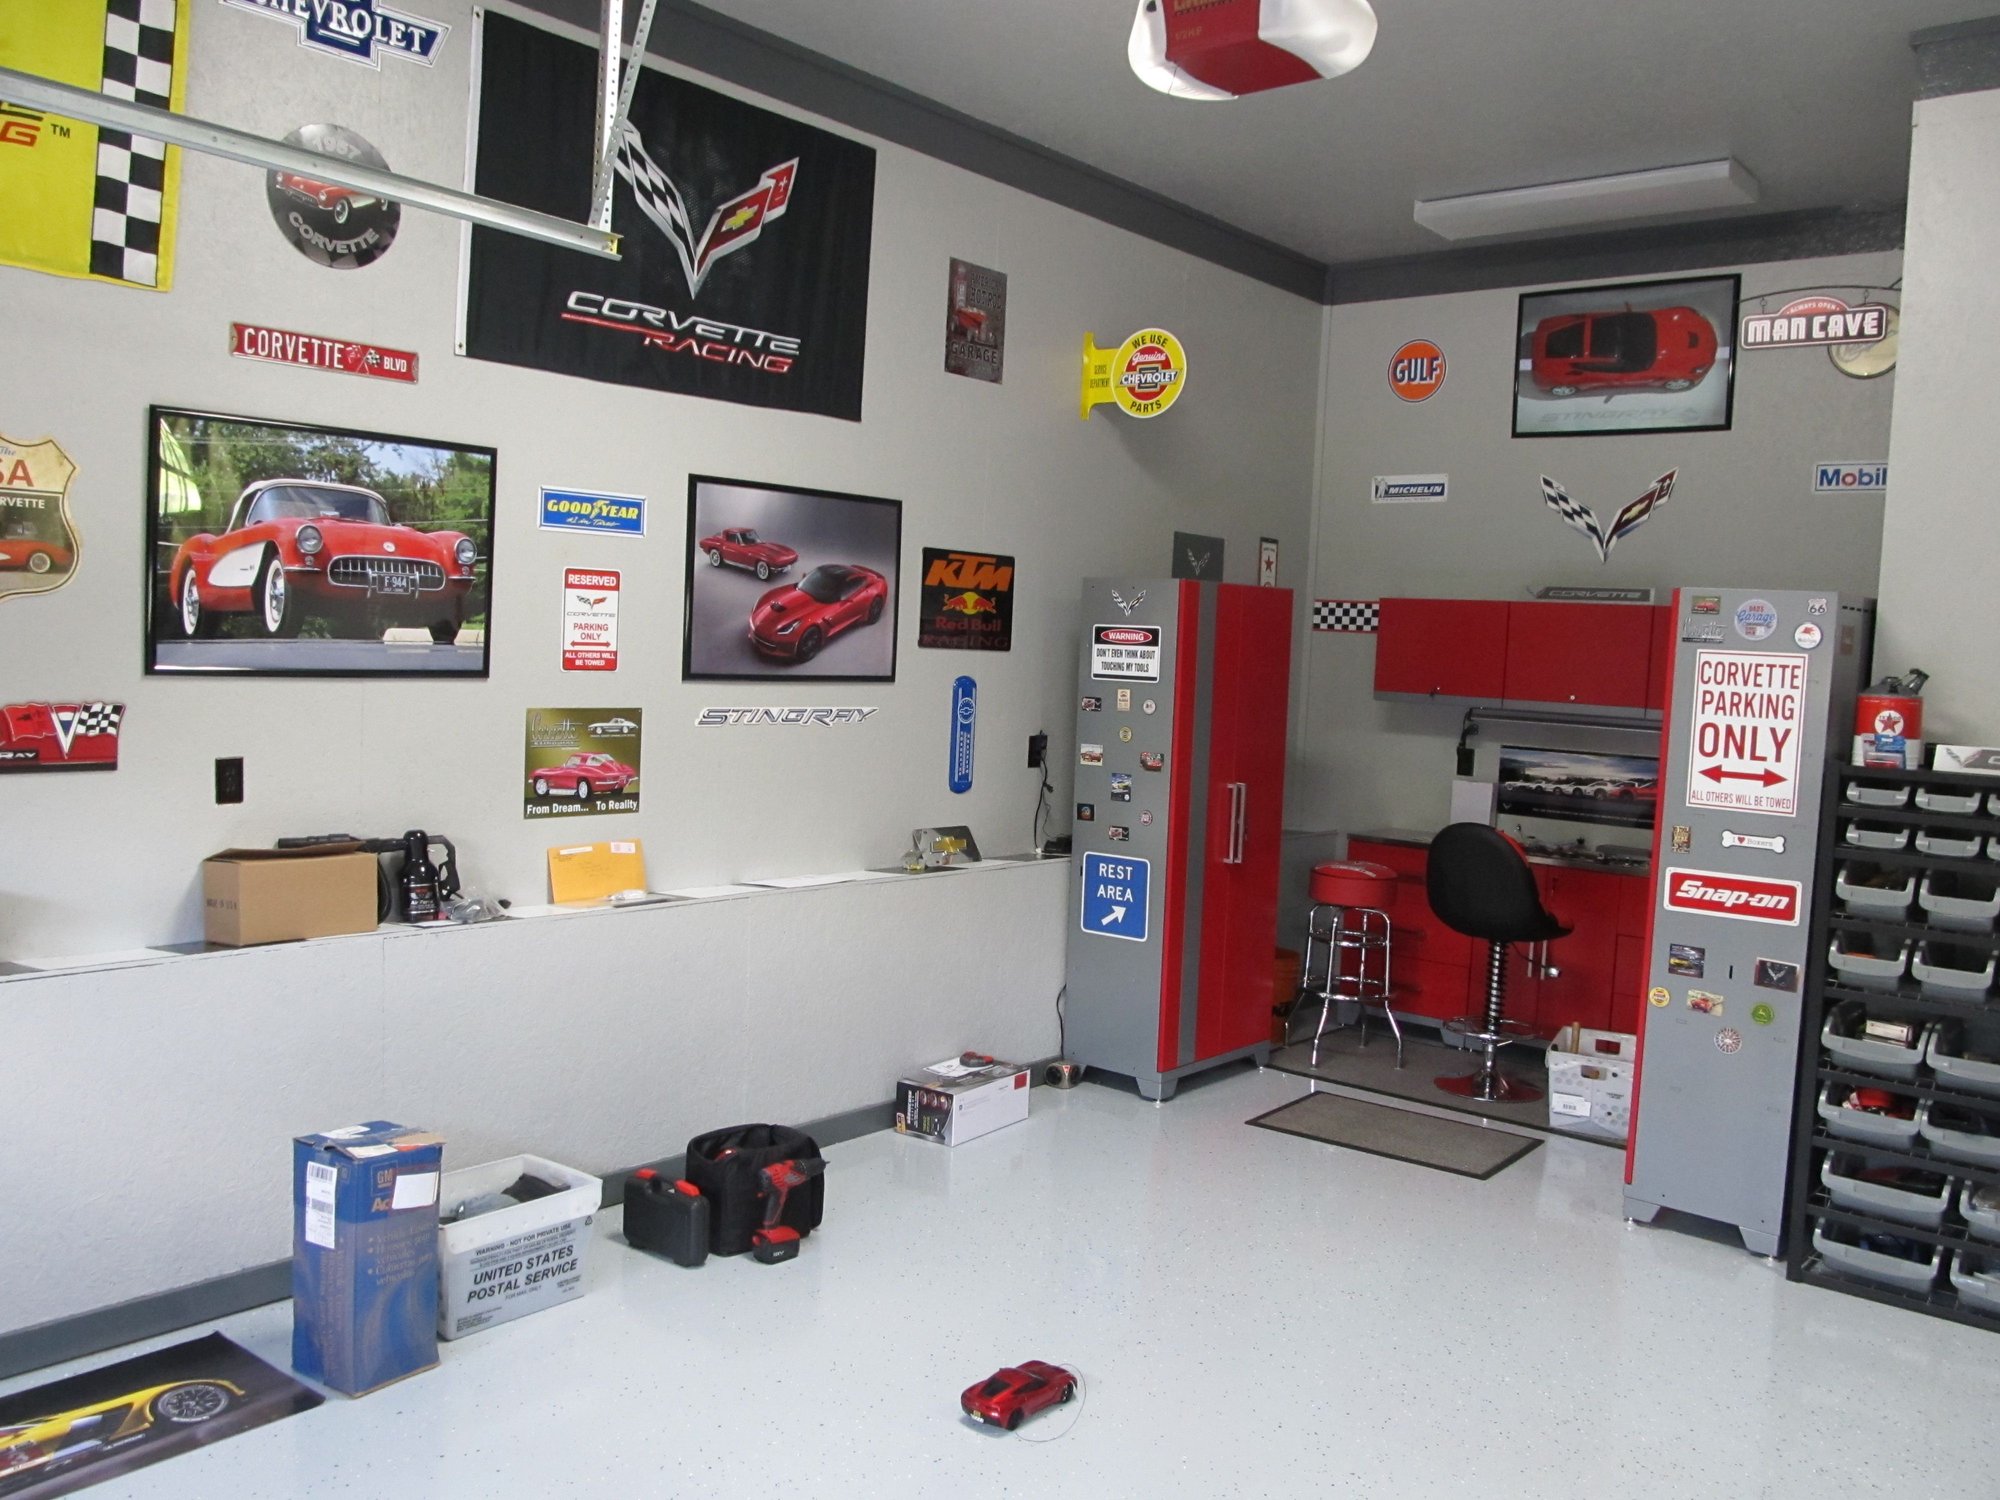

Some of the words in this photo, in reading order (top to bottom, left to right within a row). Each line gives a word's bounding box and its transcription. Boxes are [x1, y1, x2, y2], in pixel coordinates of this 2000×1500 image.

[256, 0, 427, 53] HEVROLET
[289, 211, 379, 254] CORVETTE
[566, 290, 802, 356] CORVETTE
[1747, 317, 1807, 344] MAN
[1812, 311, 1880, 340] CAVE
[243, 327, 345, 370] CORVETTE
[383, 356, 407, 373] BLVD
[1131, 334, 1147, 349] WE
[1149, 334, 1168, 348] USE
[643, 332, 794, 374] RACING
[951, 340, 997, 365] GARAGE
[1131, 351, 1167, 366] Genuine
[1121, 371, 1177, 385] CHEVROLET
[1393, 355, 1442, 385] GULF
[1130, 399, 1162, 413] PARTS
[1819, 467, 1888, 487] Mobil
[1388, 485, 1443, 495] MICHELIN
[546, 499, 639, 520] GOODYEAR
[567, 573, 617, 587] RESERVED
[924, 553, 1013, 592] KTM
[1548, 590, 1642, 599] CORVETTE
[1736, 609, 1776, 625] Garage
[1809, 604, 1827, 614] 66
[573, 622, 609, 632] PARKING
[935, 616, 969, 631] Red
[971, 619, 1002, 632] Bull
[580, 632, 601, 641] ONLY
[1108, 631, 1144, 641] WARNING
[1111, 648, 1124, 658] EVEN
[1124, 649, 1138, 659] THINK
[1139, 650, 1155, 660] ABOUT
[1101, 661, 1125, 672] TOUCHING
[1126, 662, 1133, 672] MY
[1134, 662, 1149, 673] TOOLS
[1700, 660, 1802, 690] CORVETTE
[1700, 690, 1795, 721] PARKING
[697, 706, 879, 727] STINGRAY
[1698, 721, 1792, 763] ONLY
[526, 804, 550, 815] From
[552, 802, 589, 814] Dream...
[596, 801, 607, 811] To
[608, 799, 638, 811] Reality
[1691, 790, 1704, 801] ALL
[1706, 791, 1733, 804] OTHERS
[1735, 794, 1752, 806] WILL
[1754, 795, 1763, 807] BE
[1765, 796, 1791, 810] TOWED
[1747, 838, 1773, 847] Boxers
[1098, 862, 1133, 881] REST
[1096, 883, 1134, 903] AREA
[1675, 879, 1790, 910] Snap-on
[376, 1168, 394, 1184] GM
[475, 1243, 505, 1256] WARNING
[509, 1238, 523, 1247] NOT
[523, 1234, 536, 1243] FOR
[536, 1226, 560, 1240] PRIVATE
[560, 1222, 572, 1231] USE
[473, 1261, 523, 1286] UNITED
[526, 1244, 574, 1270] STATES
[466, 1278, 521, 1304] POSTAL
[524, 1258, 579, 1286] SERVICE
